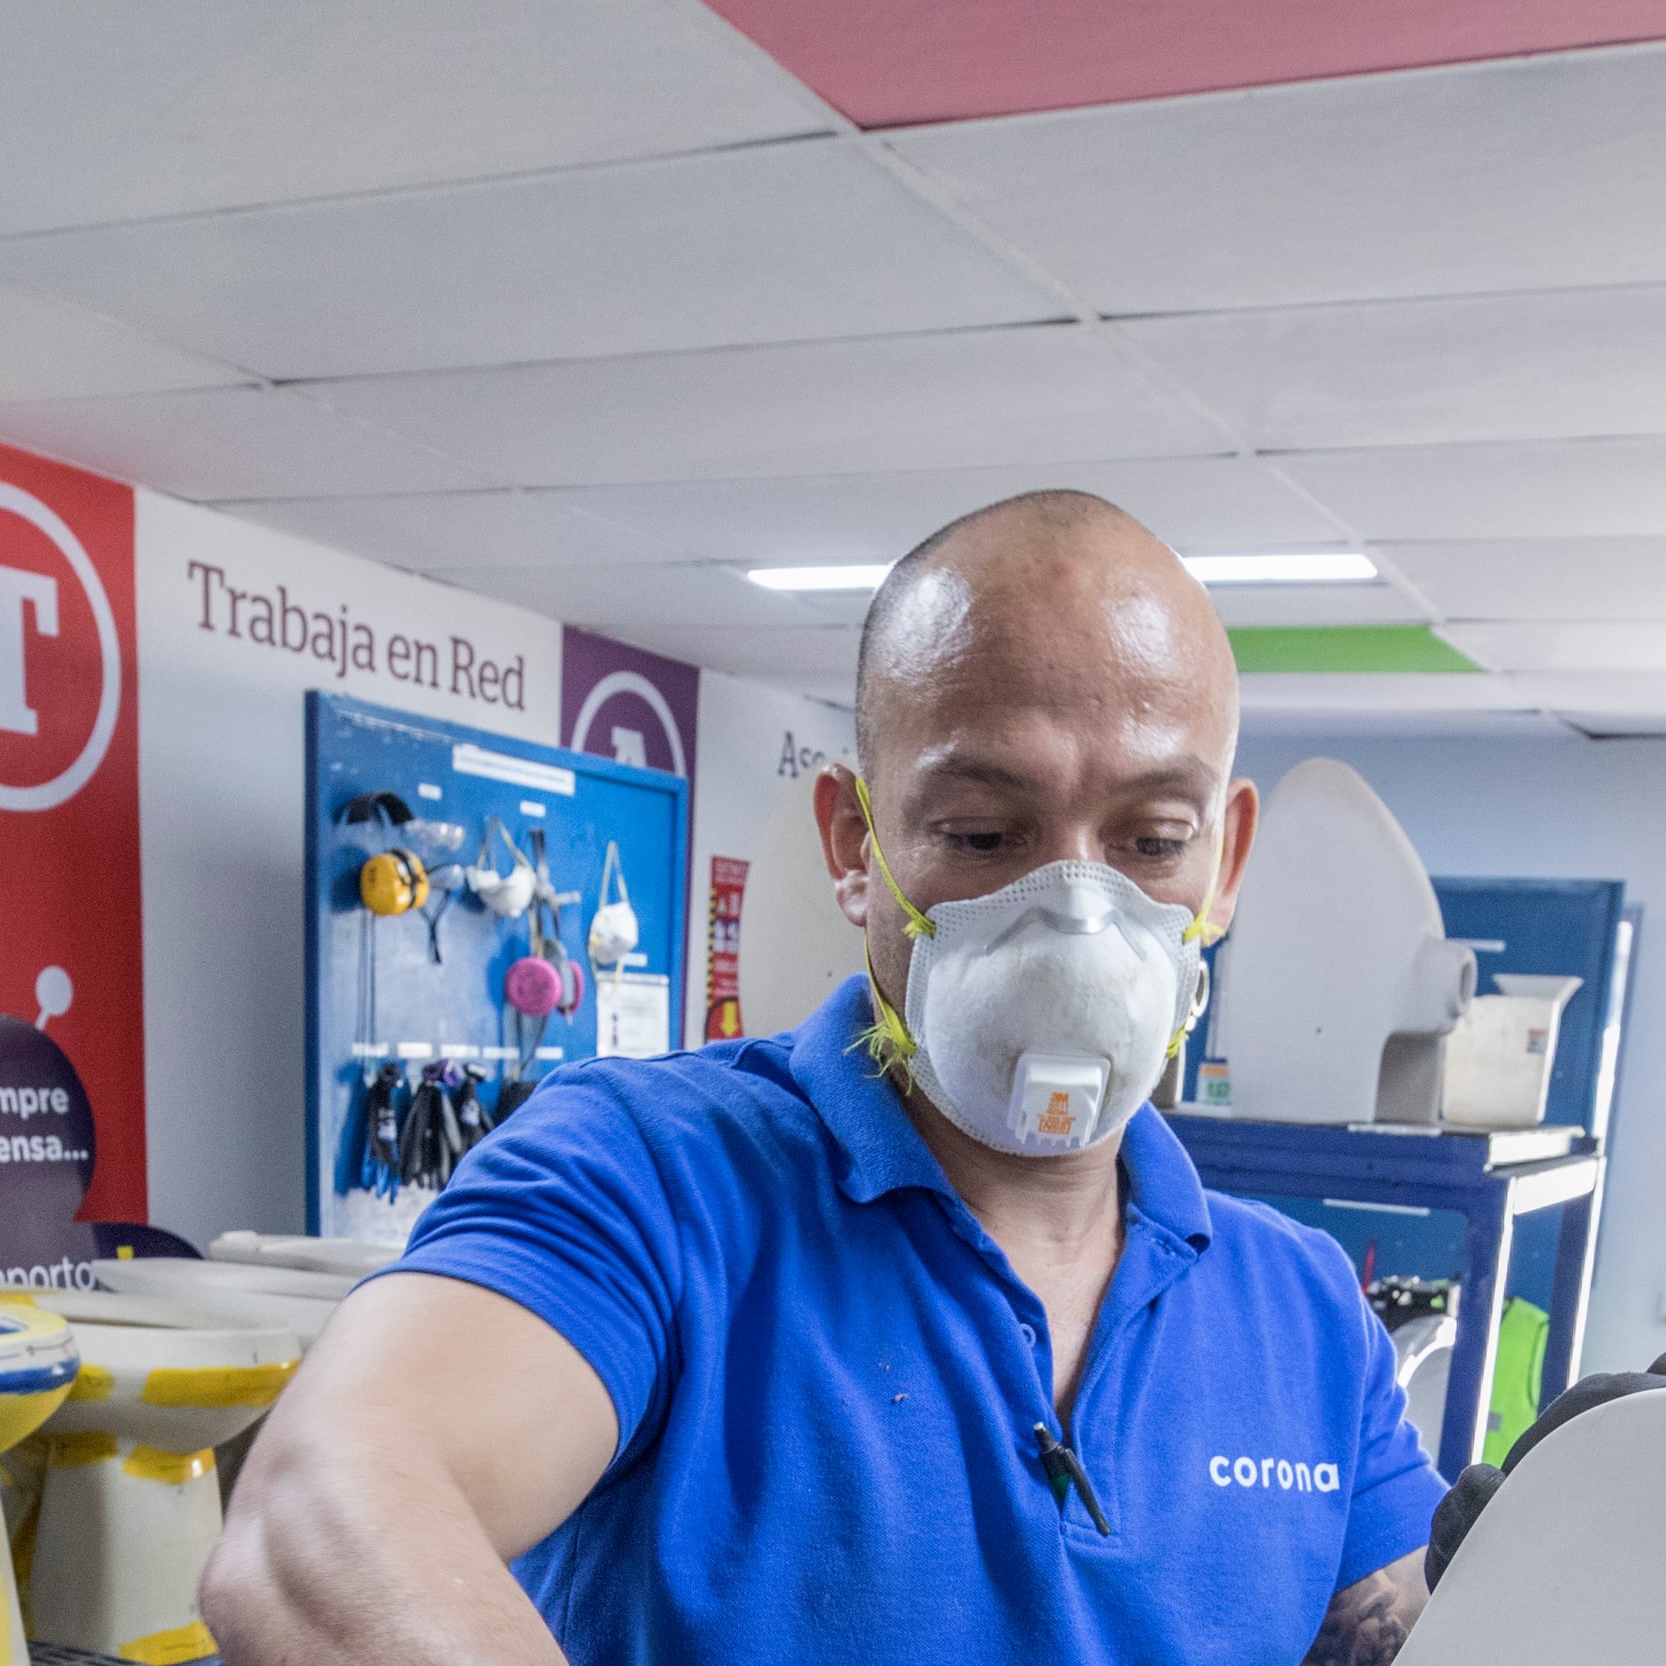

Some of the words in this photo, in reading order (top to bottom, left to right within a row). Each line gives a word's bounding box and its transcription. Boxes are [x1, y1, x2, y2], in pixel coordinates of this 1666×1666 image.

[188, 560, 376, 678] Trabaja
[389, 634, 439, 689] en
[450, 636, 527, 711] Red
[1209, 1455, 1339, 1491] corona
